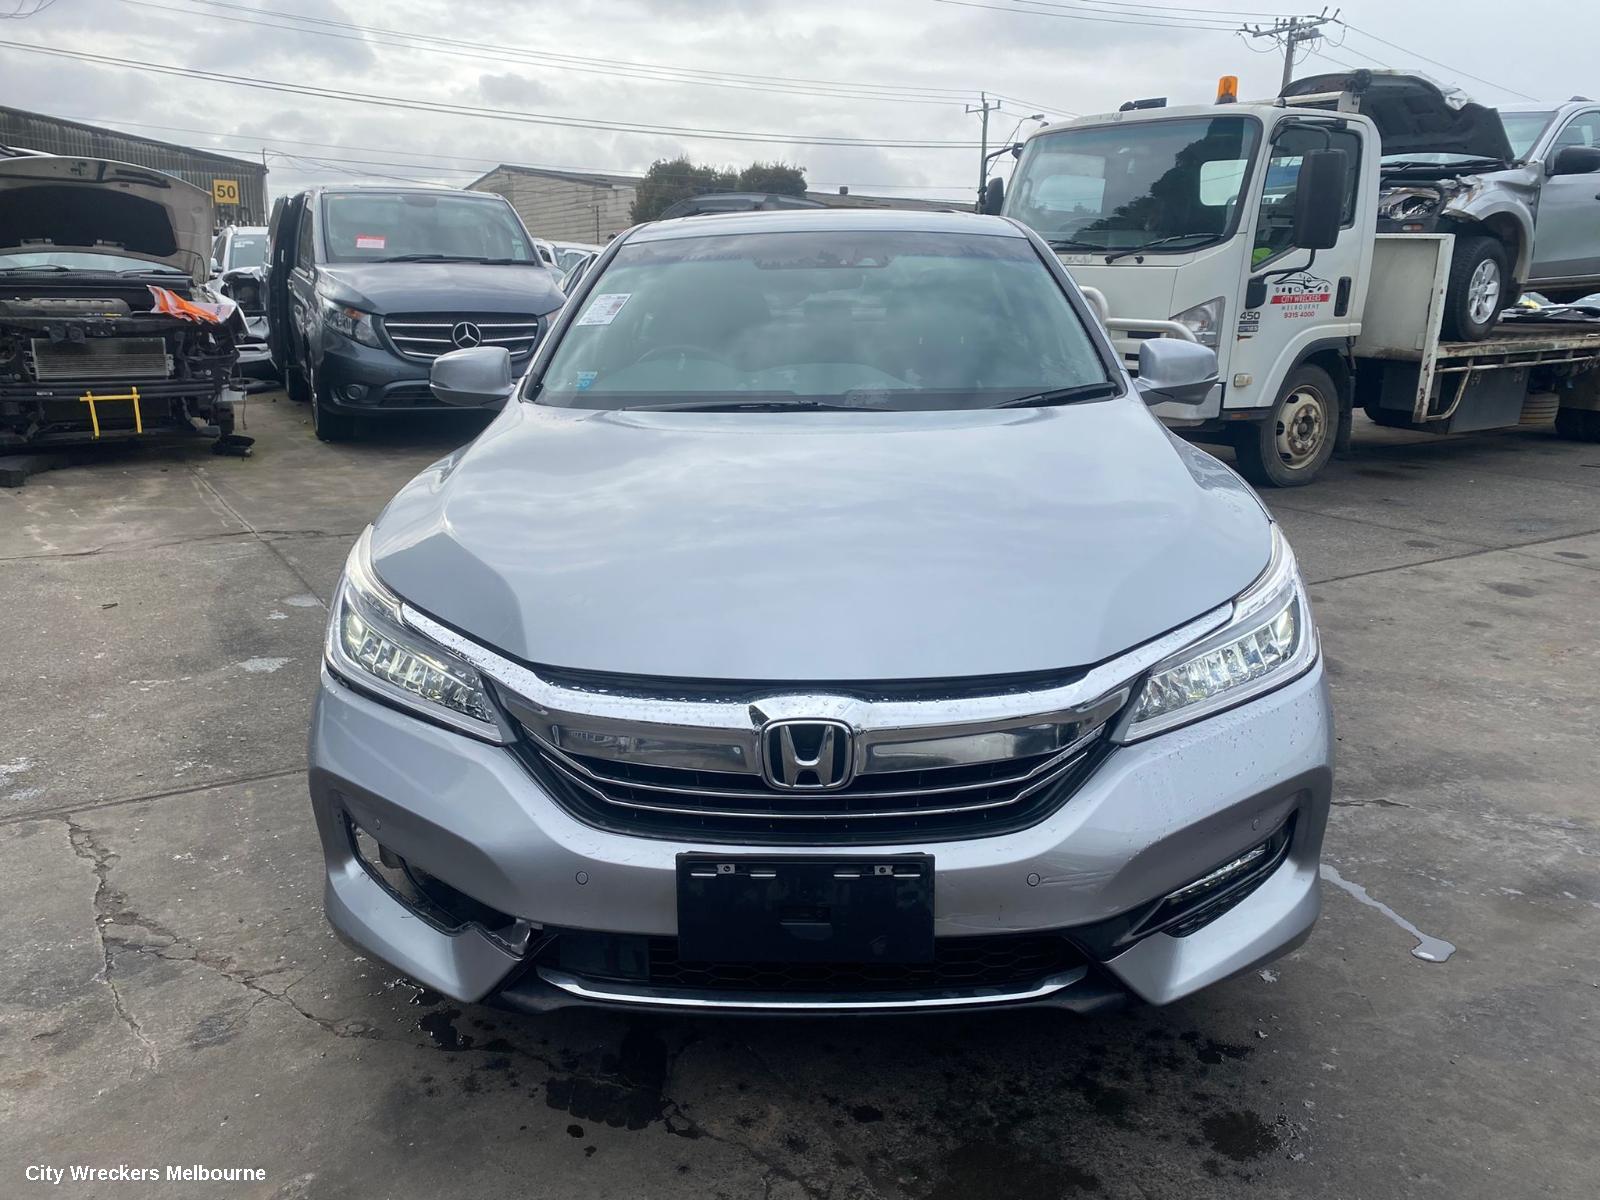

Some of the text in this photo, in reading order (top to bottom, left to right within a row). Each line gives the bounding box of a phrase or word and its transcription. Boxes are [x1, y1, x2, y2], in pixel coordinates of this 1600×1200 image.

[217, 185, 236, 198] 50
[1281, 294, 1321, 303] CITY WRECKERS
[1240, 311, 1260, 320] 450
